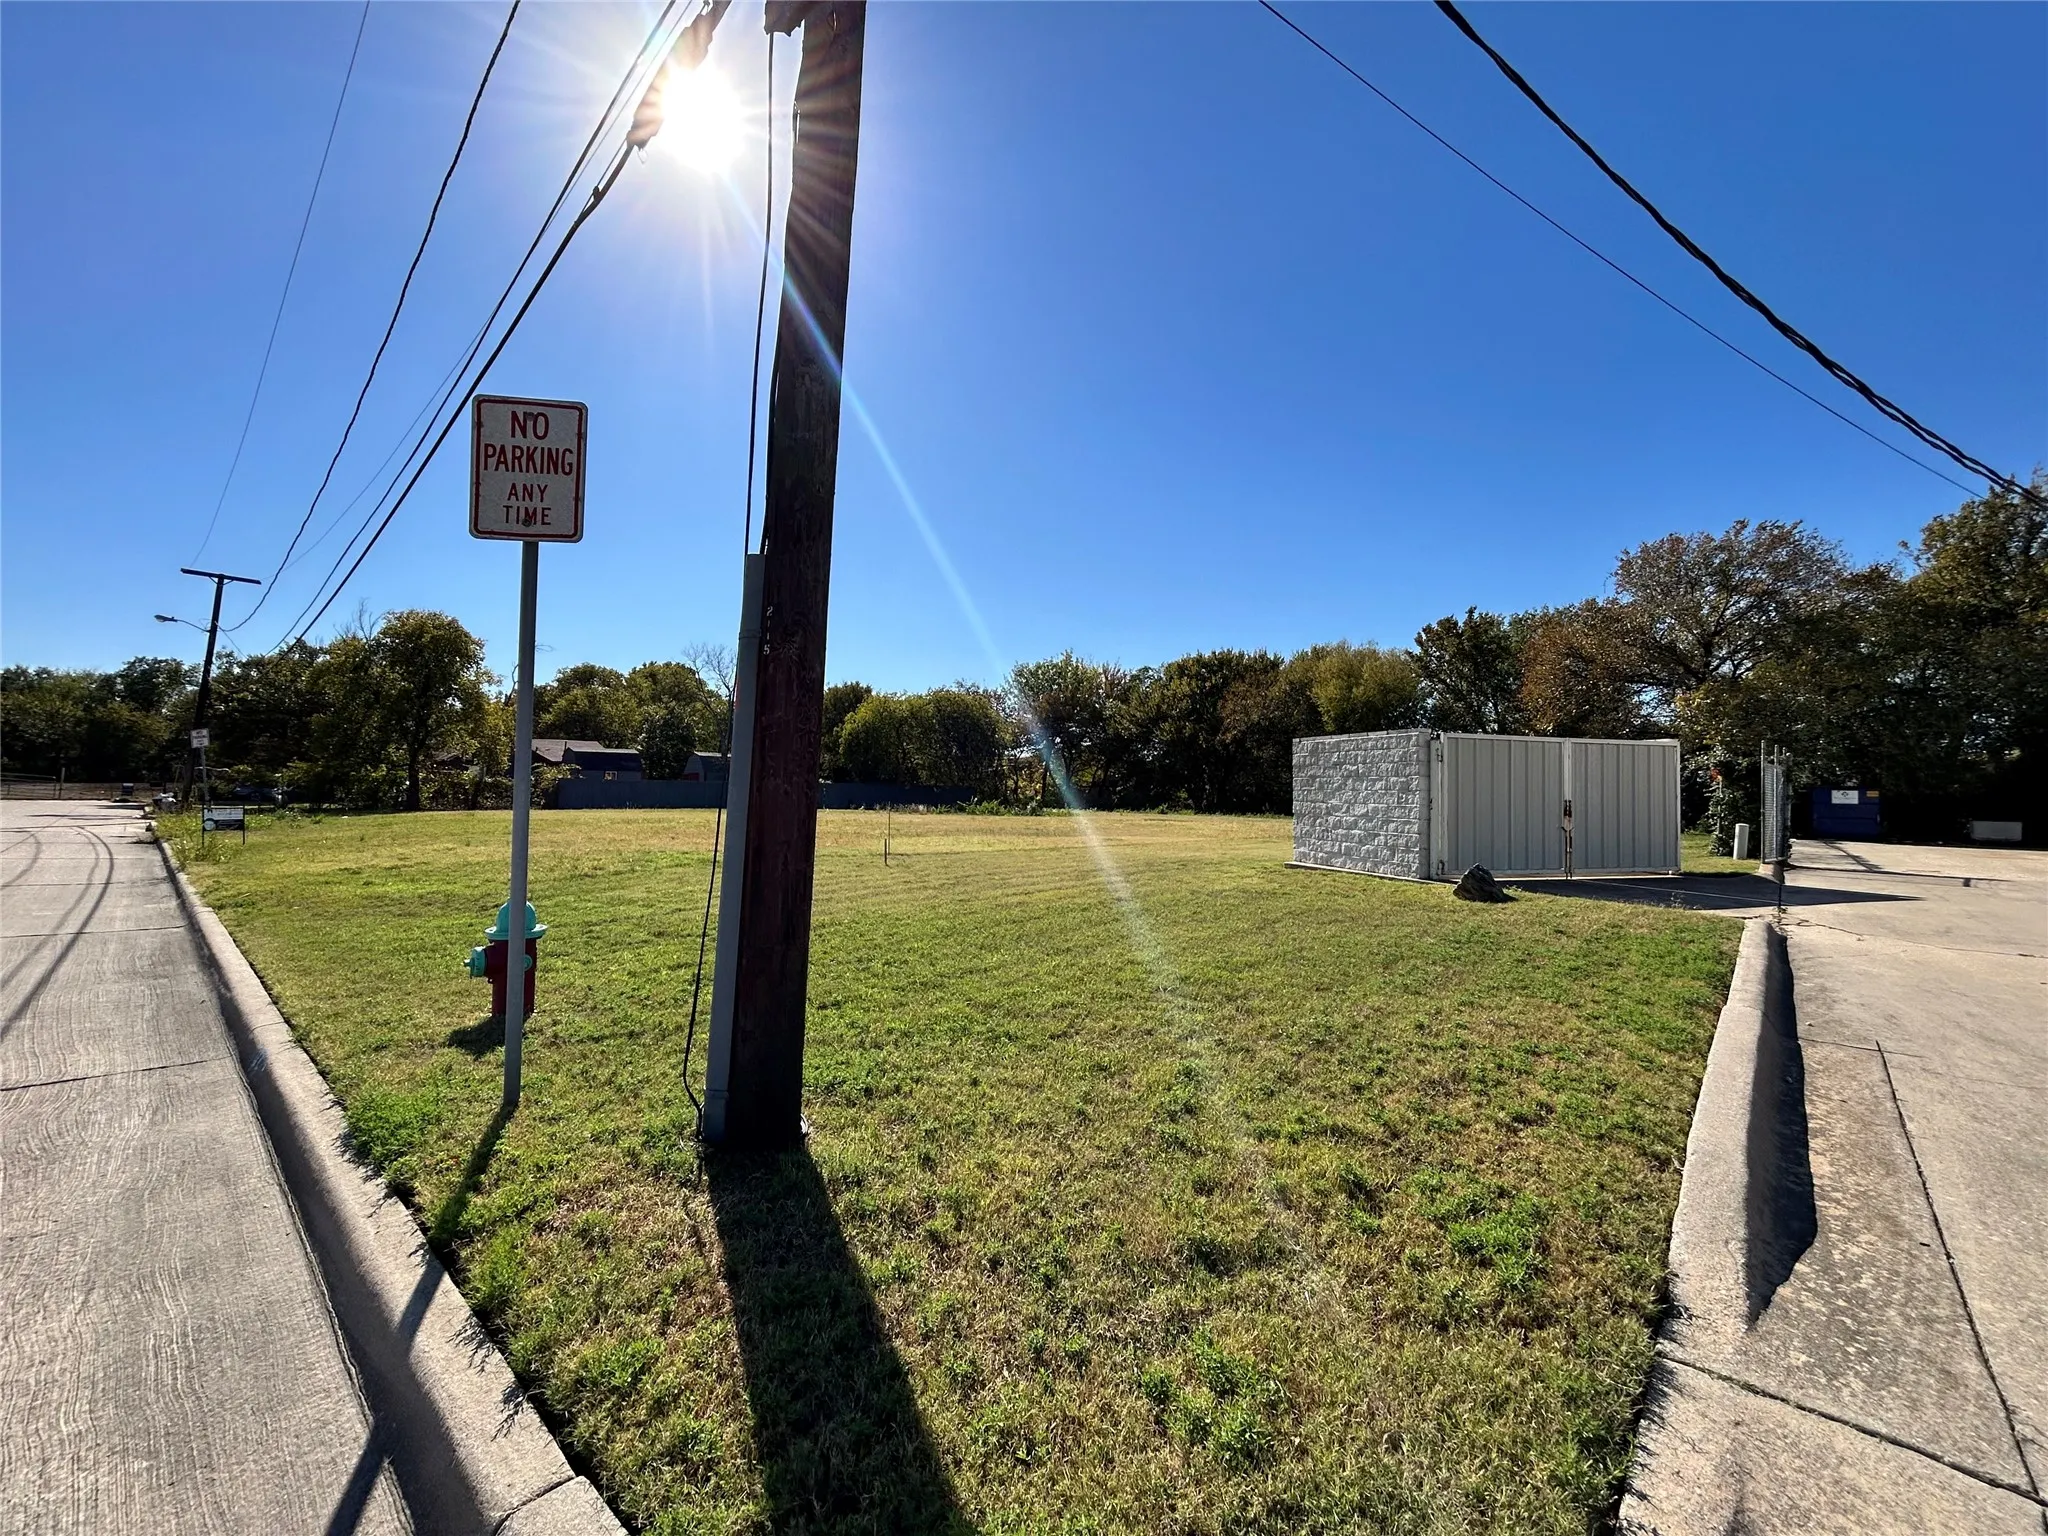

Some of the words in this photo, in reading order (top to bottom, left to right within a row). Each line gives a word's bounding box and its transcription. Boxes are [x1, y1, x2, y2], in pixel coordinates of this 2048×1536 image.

[511, 411, 549, 440] NO
[483, 443, 573, 476] PARKING
[507, 482, 548, 502] ANY
[503, 505, 551, 526] TIME
